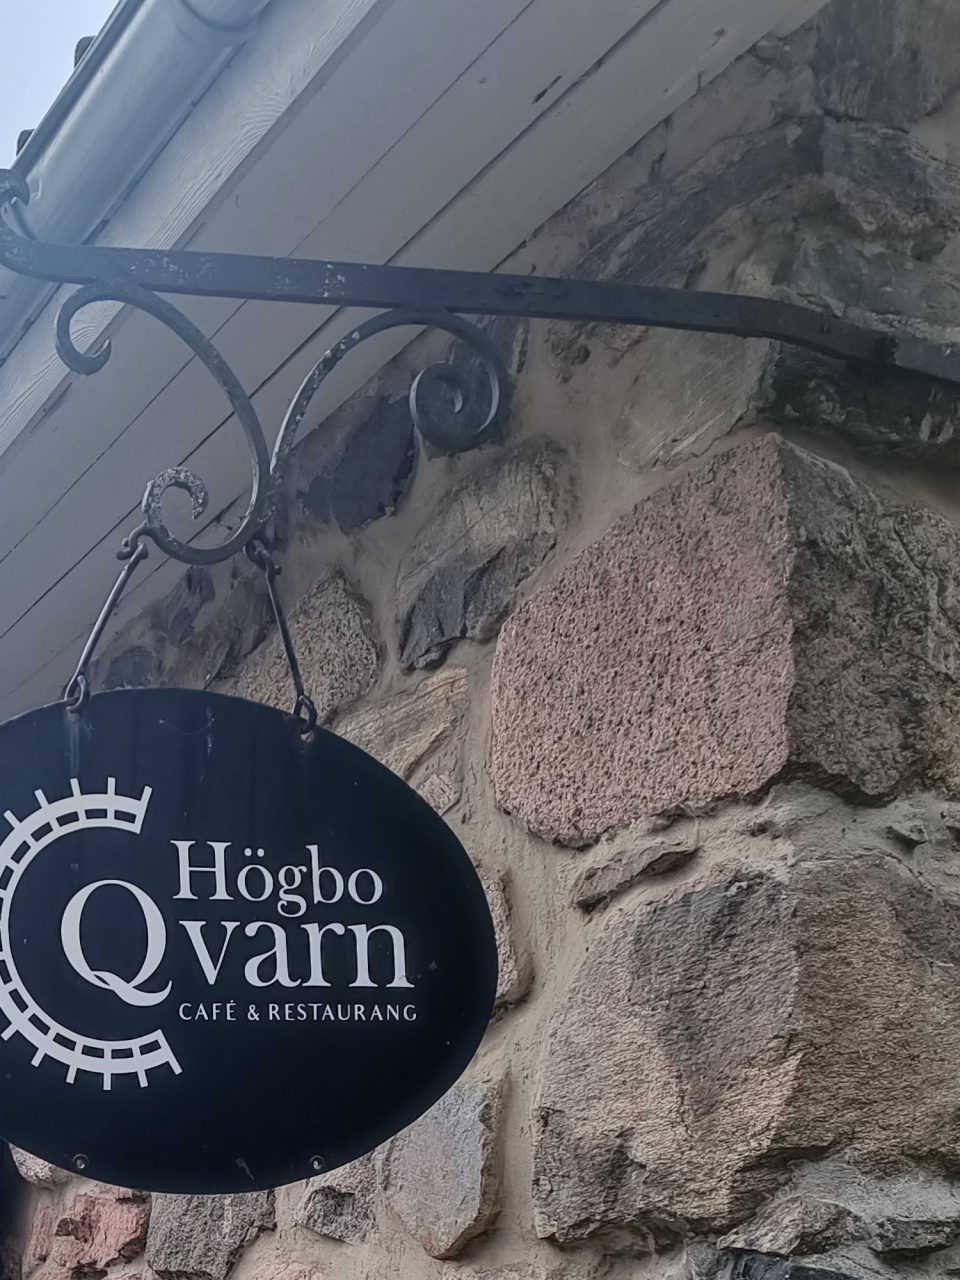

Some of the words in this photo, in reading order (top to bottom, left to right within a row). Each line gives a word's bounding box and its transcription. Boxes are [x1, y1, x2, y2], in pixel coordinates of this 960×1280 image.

[170, 840, 383, 918] Högbo
[60, 879, 415, 1007] Qvarn
[178, 999, 237, 1021] CAFÉ
[247, 1004, 260, 1021] &
[269, 1003, 418, 1021] RESTAURANG
